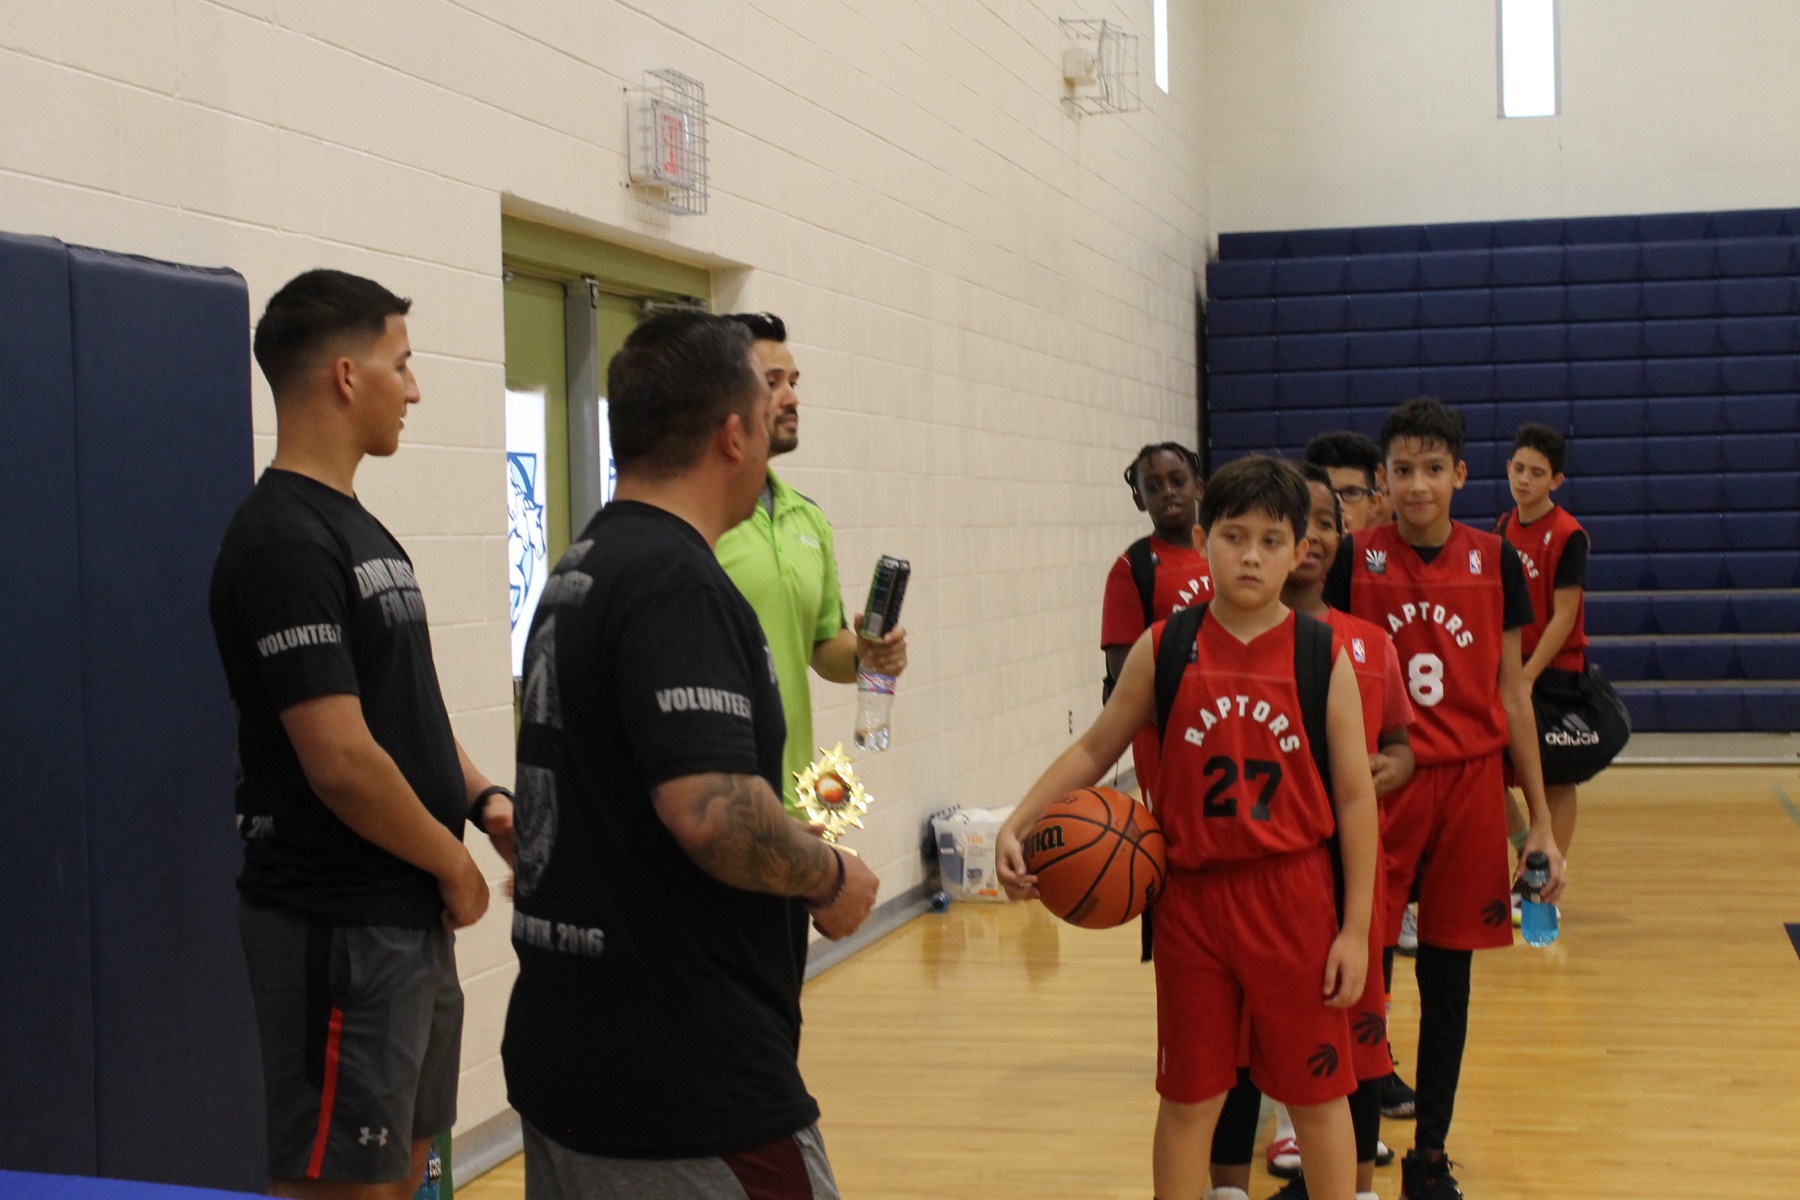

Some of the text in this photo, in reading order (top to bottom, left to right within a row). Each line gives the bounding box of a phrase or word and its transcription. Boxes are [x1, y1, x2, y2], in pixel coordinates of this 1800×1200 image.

[1387, 601, 1474, 649] APTORS
[1407, 653, 1444, 707] 8
[1184, 695, 1301, 753] RAPTORS
[1202, 755, 1283, 822] 27
